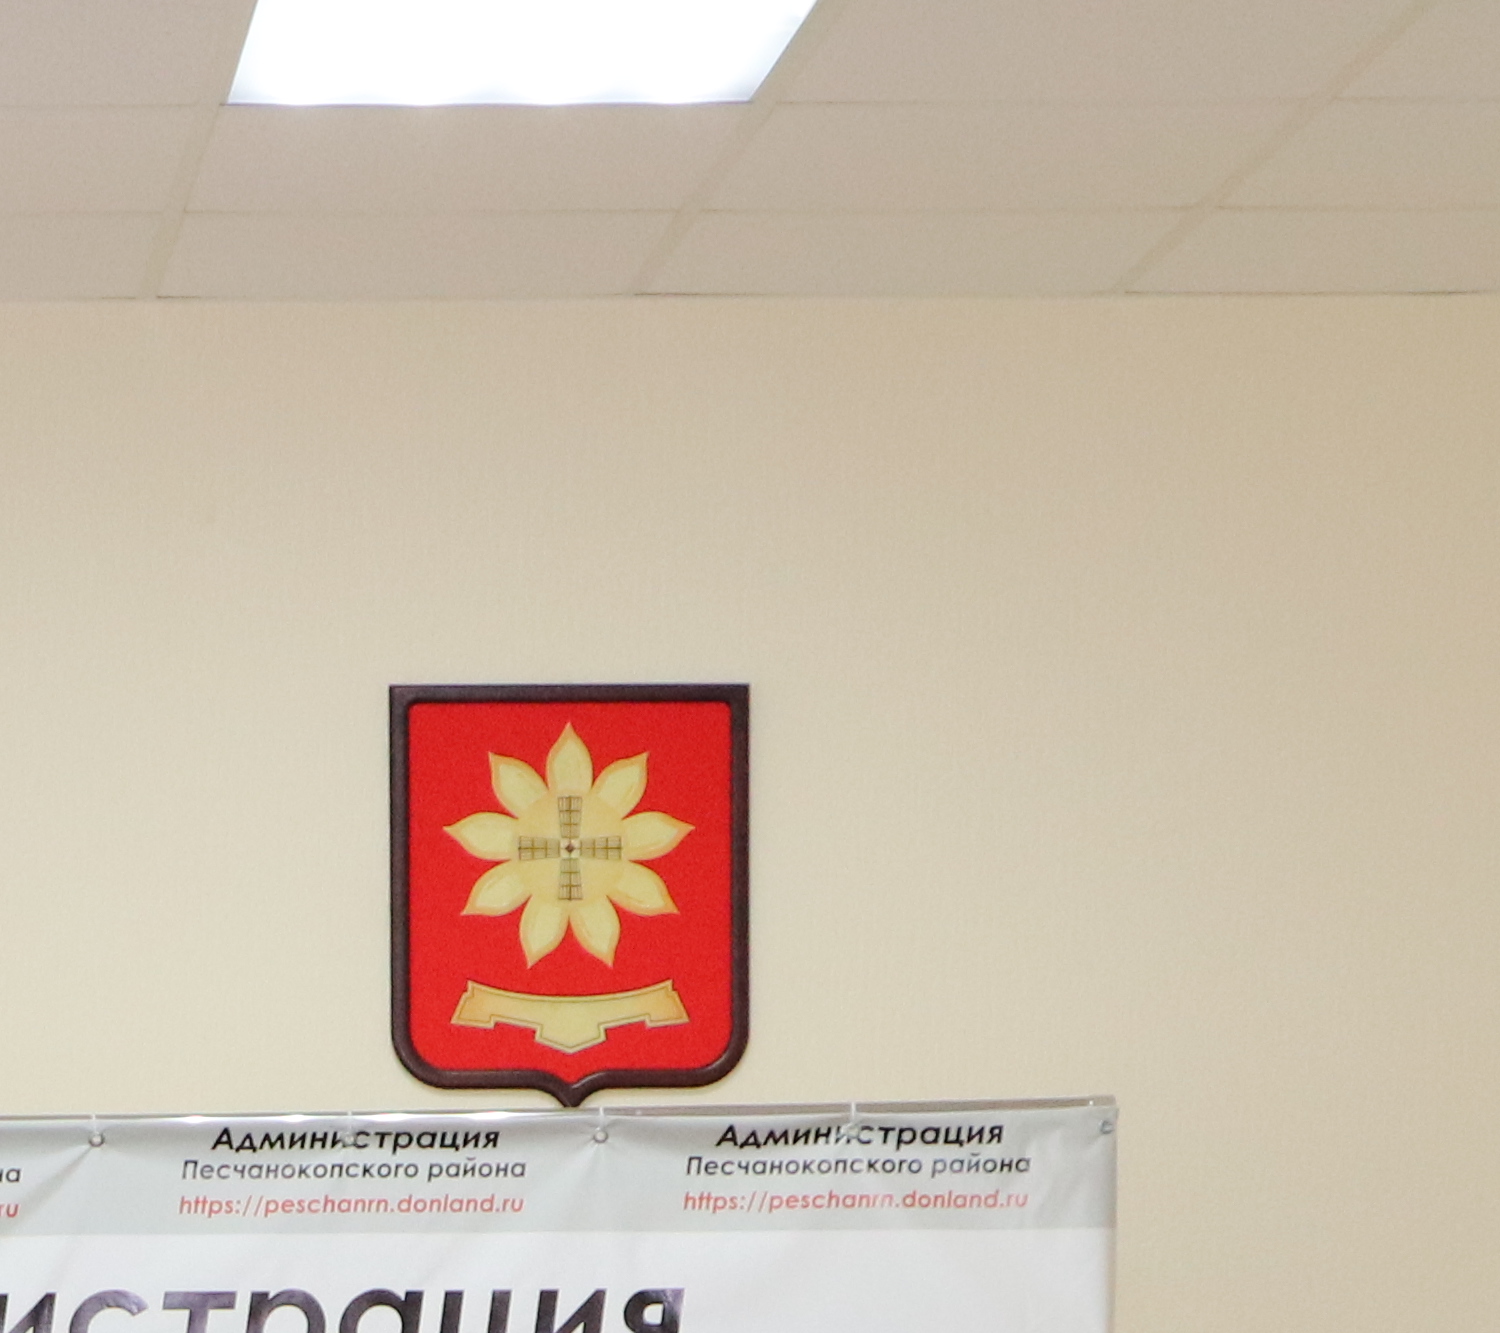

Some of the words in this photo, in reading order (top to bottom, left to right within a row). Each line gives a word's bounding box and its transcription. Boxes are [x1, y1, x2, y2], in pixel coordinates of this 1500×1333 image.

[182, 1160, 419, 1180] Песчанокопского
[427, 1157, 526, 1182] района
[686, 1156, 922, 1177] Песчанокопского
[931, 1154, 1031, 1178] района
[179, 1195, 525, 1217] https://peschanrn.donland.ru
[683, 1190, 1029, 1213] https://peschanrn.donland.ru
